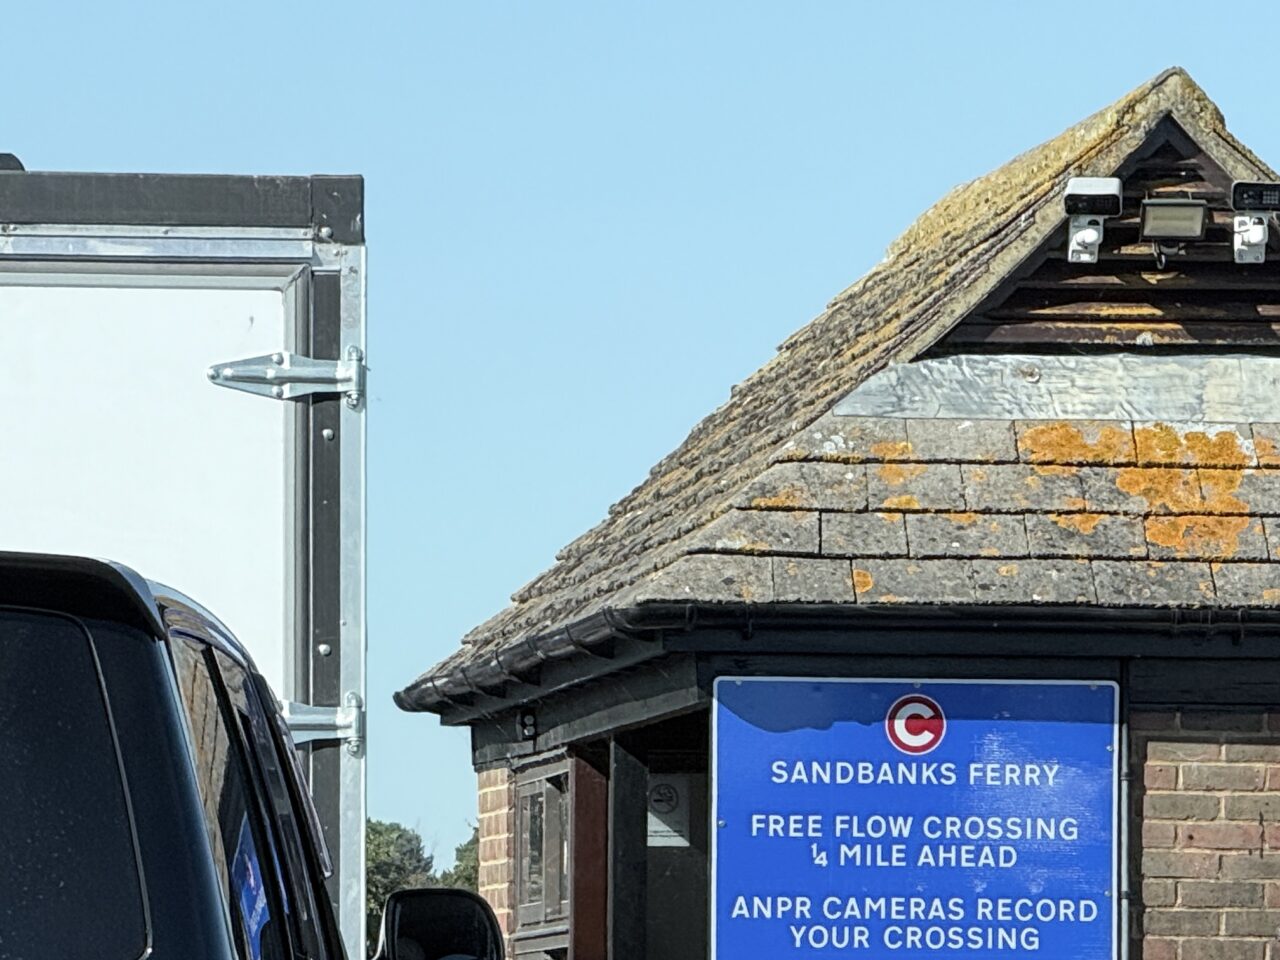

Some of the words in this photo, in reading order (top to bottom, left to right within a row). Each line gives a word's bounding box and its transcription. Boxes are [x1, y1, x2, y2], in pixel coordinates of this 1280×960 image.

[893, 702, 936, 747] C
[771, 760, 957, 785] SANDBANKS
[969, 763, 1060, 786] FERRY
[751, 814, 823, 837] FREE
[835, 815, 913, 838] FLOW
[923, 816, 1079, 841] CROSSING
[840, 844, 906, 866] MILE
[917, 845, 1018, 868] AHEAD
[731, 896, 812, 919] ANPR
[822, 897, 966, 921] CAMERAS
[977, 898, 1098, 923] RECORD
[790, 925, 870, 949] YOUR
[883, 926, 1040, 951] CROSSING
